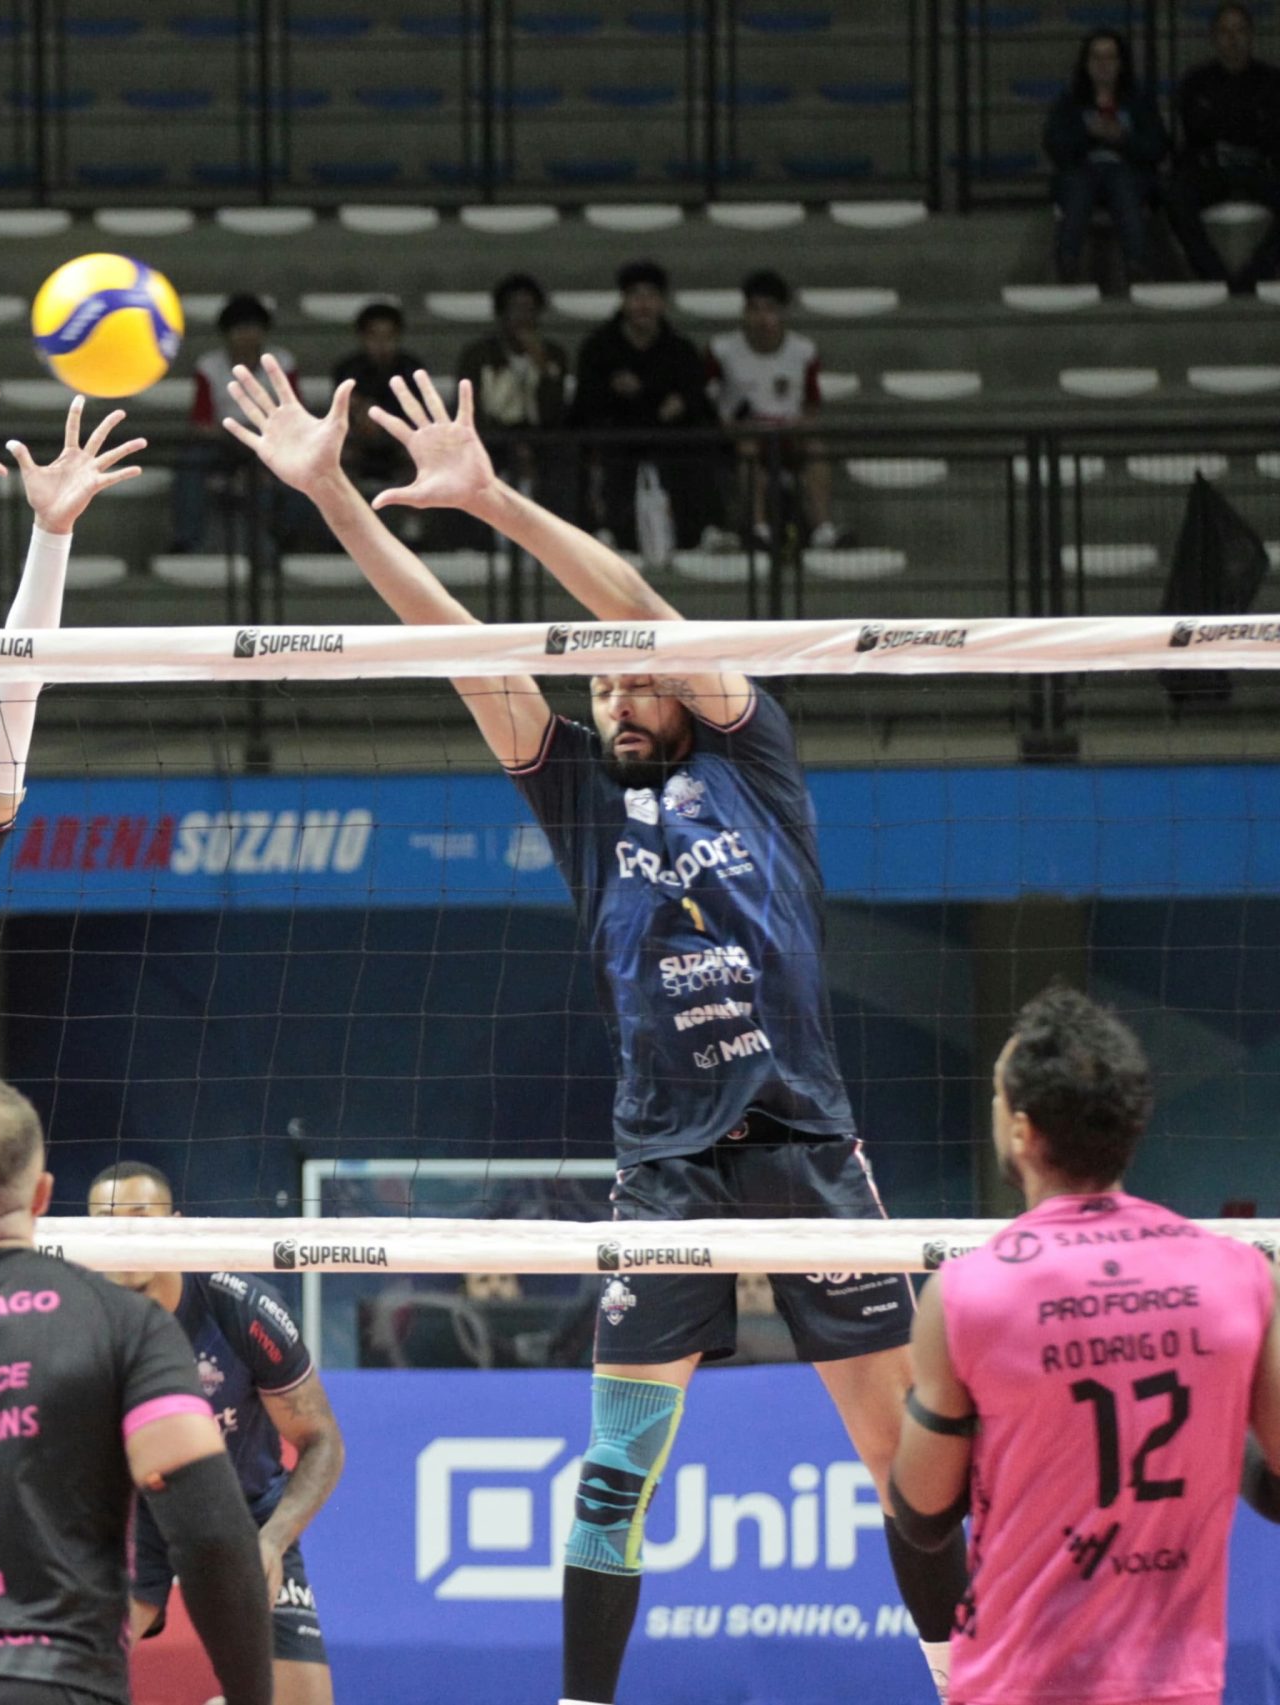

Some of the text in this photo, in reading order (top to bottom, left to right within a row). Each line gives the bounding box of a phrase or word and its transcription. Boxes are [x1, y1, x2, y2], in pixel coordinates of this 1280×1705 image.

[259, 634, 344, 655] SUPERLIGA
[570, 630, 656, 650] SUPERLIGA
[879, 629, 968, 649] SUPERLIGA
[1195, 622, 1280, 643] SUPERLIG
[14, 808, 374, 875] ARENA SUZANO
[636, 830, 749, 889] Report
[659, 945, 751, 979] SUZANO
[662, 966, 756, 997] SHOPPING
[1054, 1224, 1201, 1247] SANEAGO
[298, 1245, 388, 1267] SUPERLIGA
[623, 1247, 713, 1268] SUPERLIGA
[259, 1295, 300, 1343] necton
[1038, 1285, 1200, 1325] PROFORCE
[1042, 1327, 1214, 1373] RODRIGO L
[1068, 1369, 1192, 1509] 12
[644, 1604, 721, 1638] SEU
[725, 1603, 868, 1641] SONHO,
